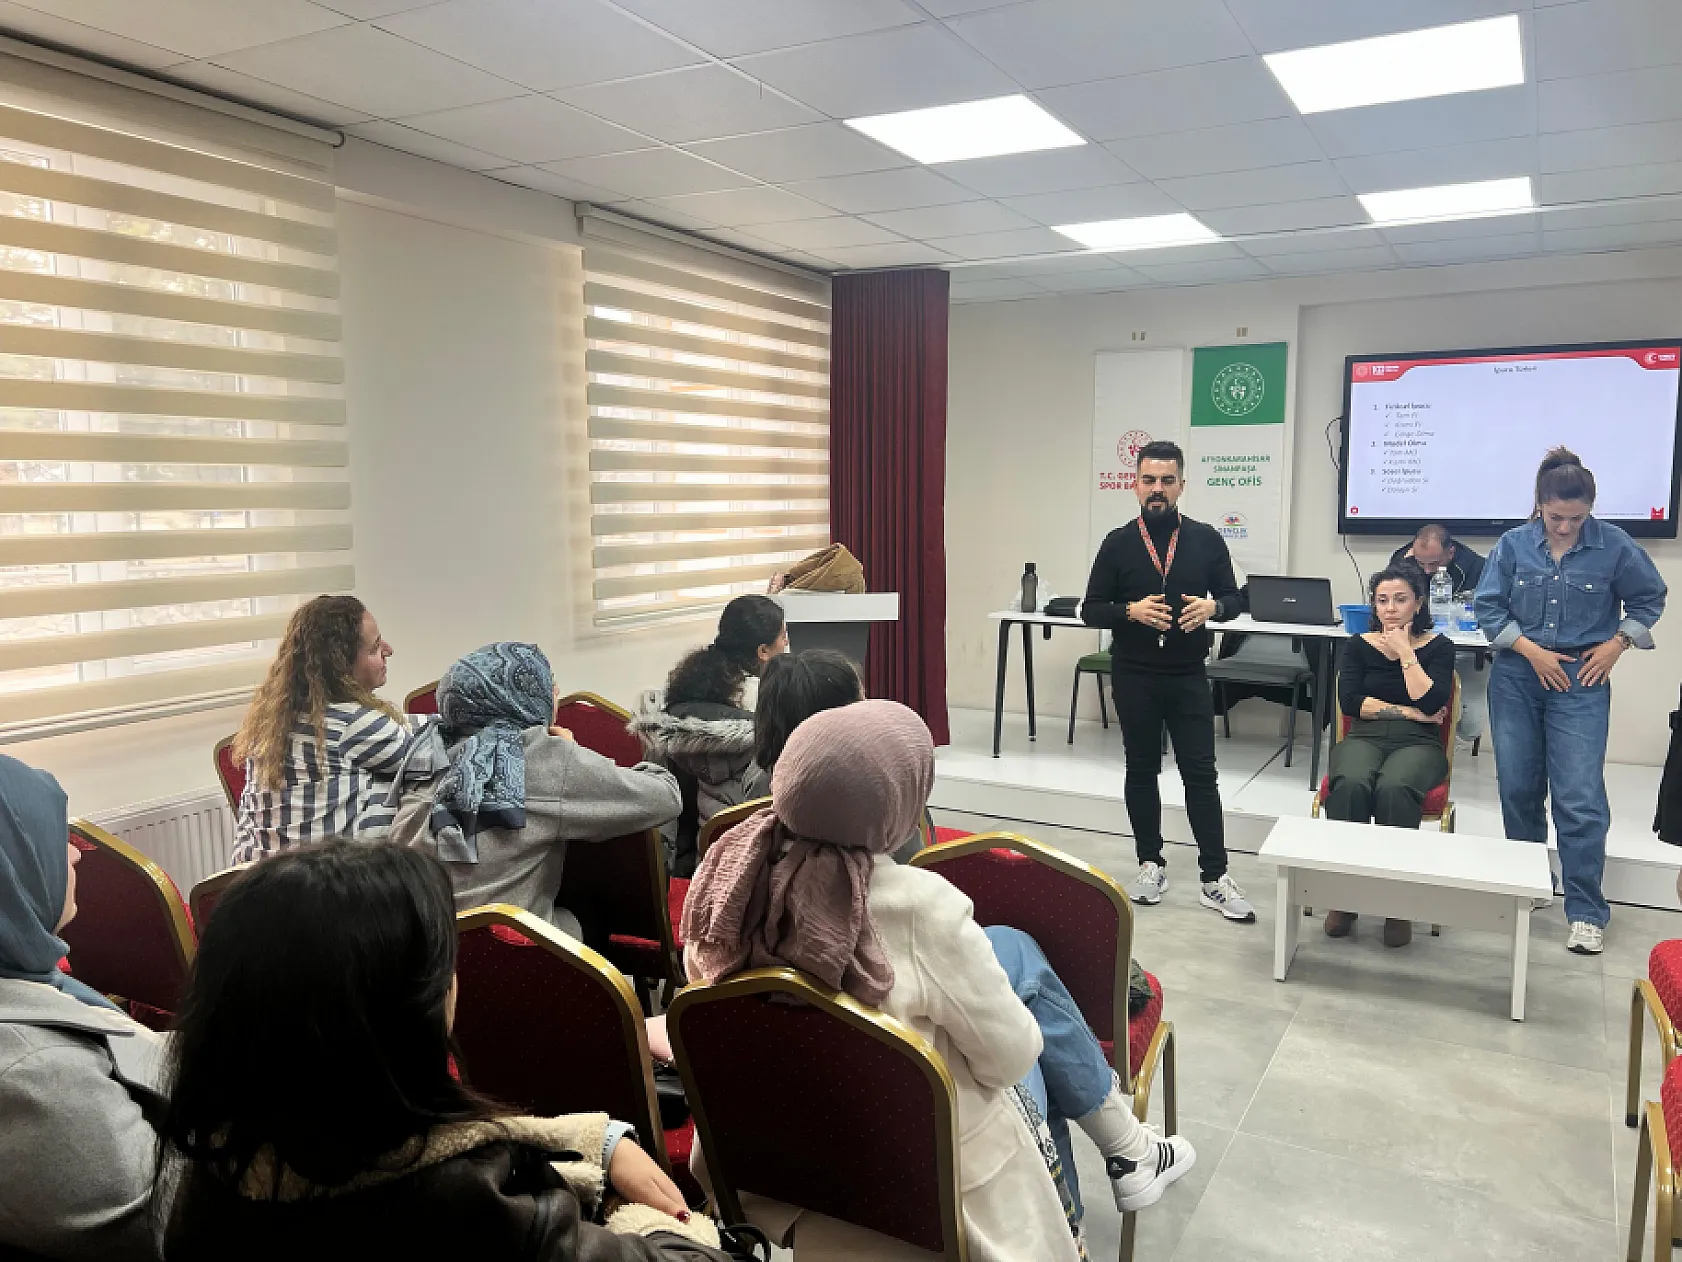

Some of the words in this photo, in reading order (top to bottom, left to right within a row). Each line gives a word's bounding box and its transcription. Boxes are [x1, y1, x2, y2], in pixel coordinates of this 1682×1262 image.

[1100, 482, 1122, 490] SPOR
[1206, 476, 1236, 489] GENÇ
[1238, 474, 1263, 487] OFİS
